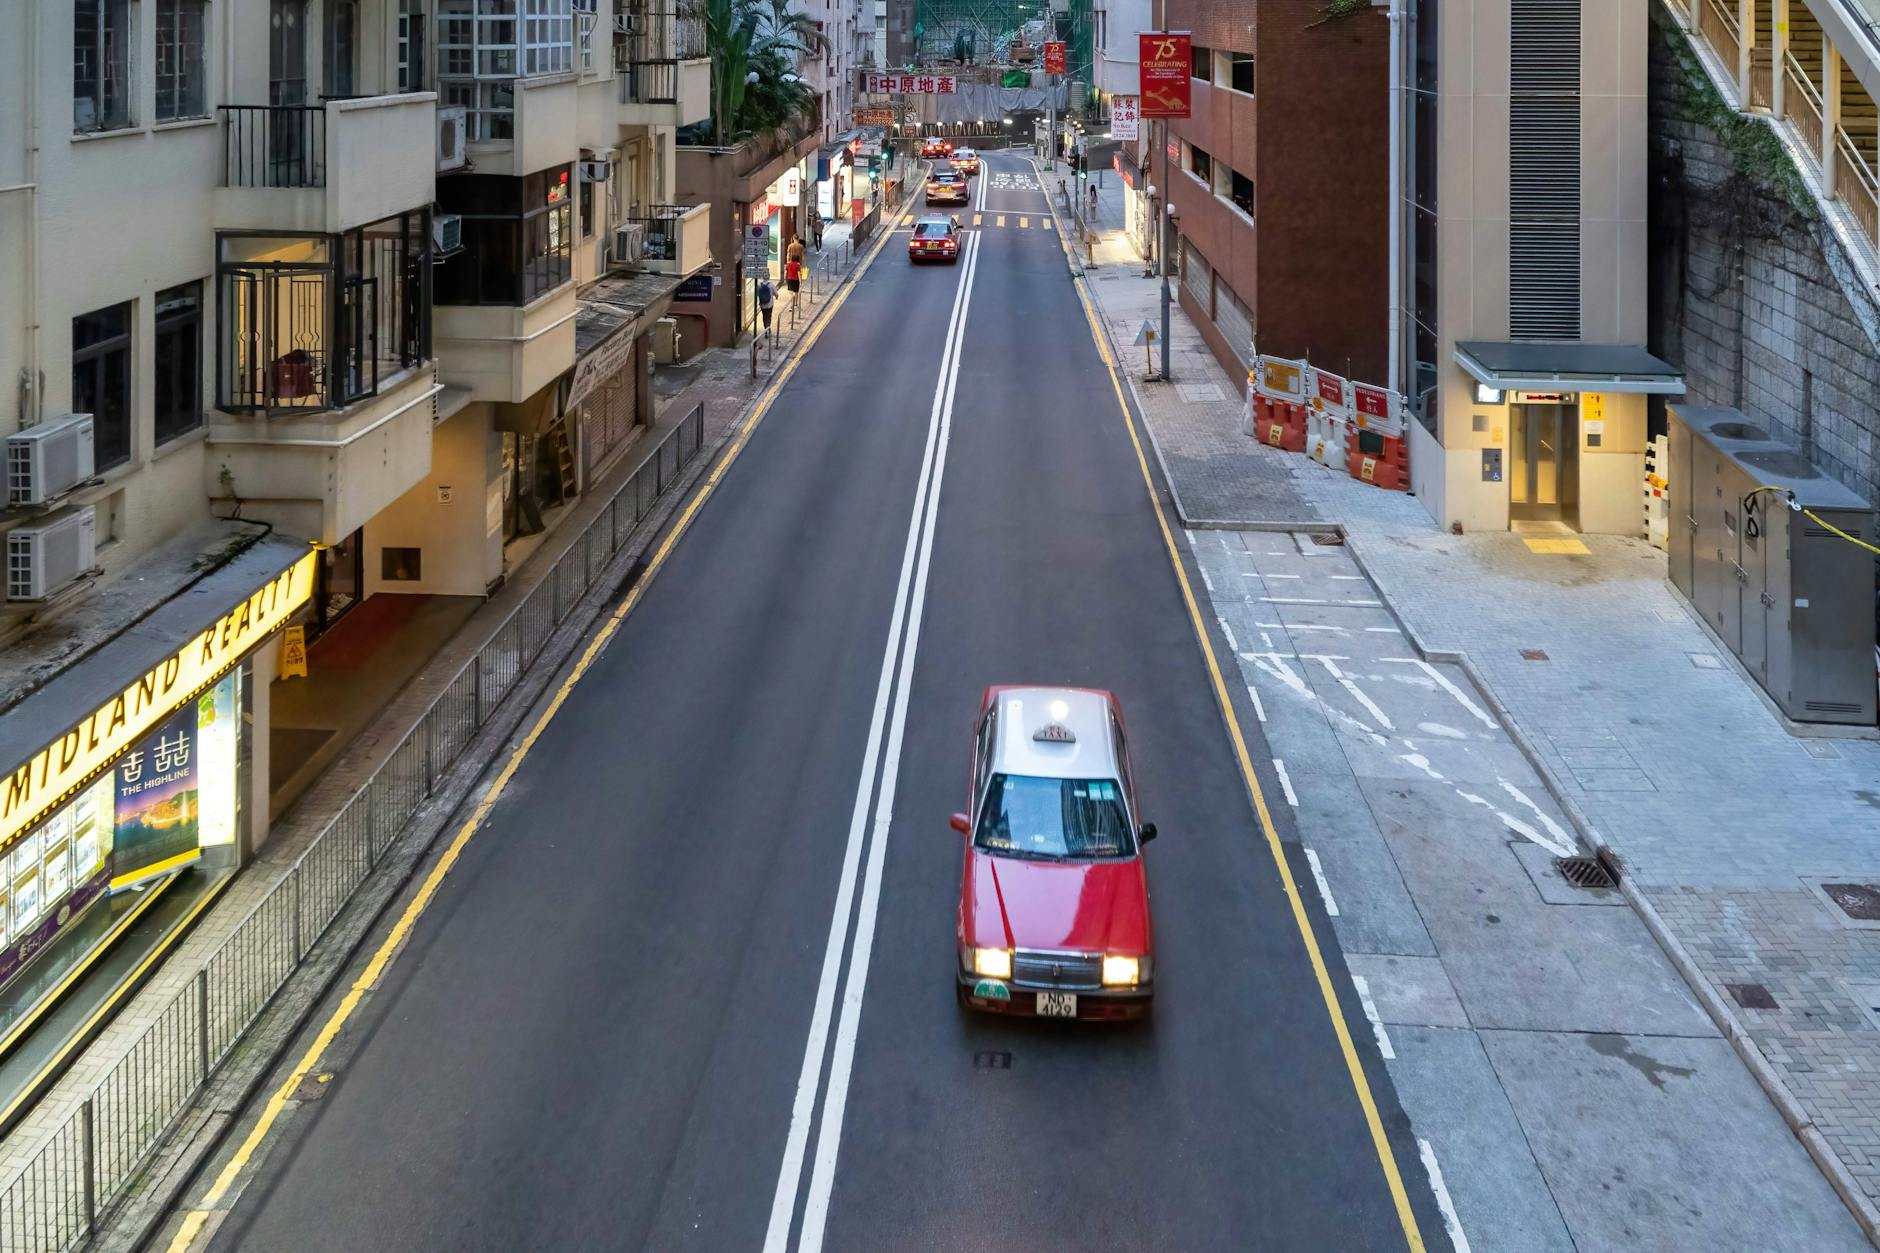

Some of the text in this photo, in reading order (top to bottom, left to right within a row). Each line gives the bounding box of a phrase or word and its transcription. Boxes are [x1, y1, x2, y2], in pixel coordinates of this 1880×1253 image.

[1152, 38, 1177, 60] 75
[879, 76, 953, 94] 中原地產
[3, 565, 295, 820] MIDLAND REALTY
[121, 767, 190, 797] THE HIGHLINE
[1048, 993, 1065, 1003] ND
[1042, 1003, 1072, 1017] 4129
